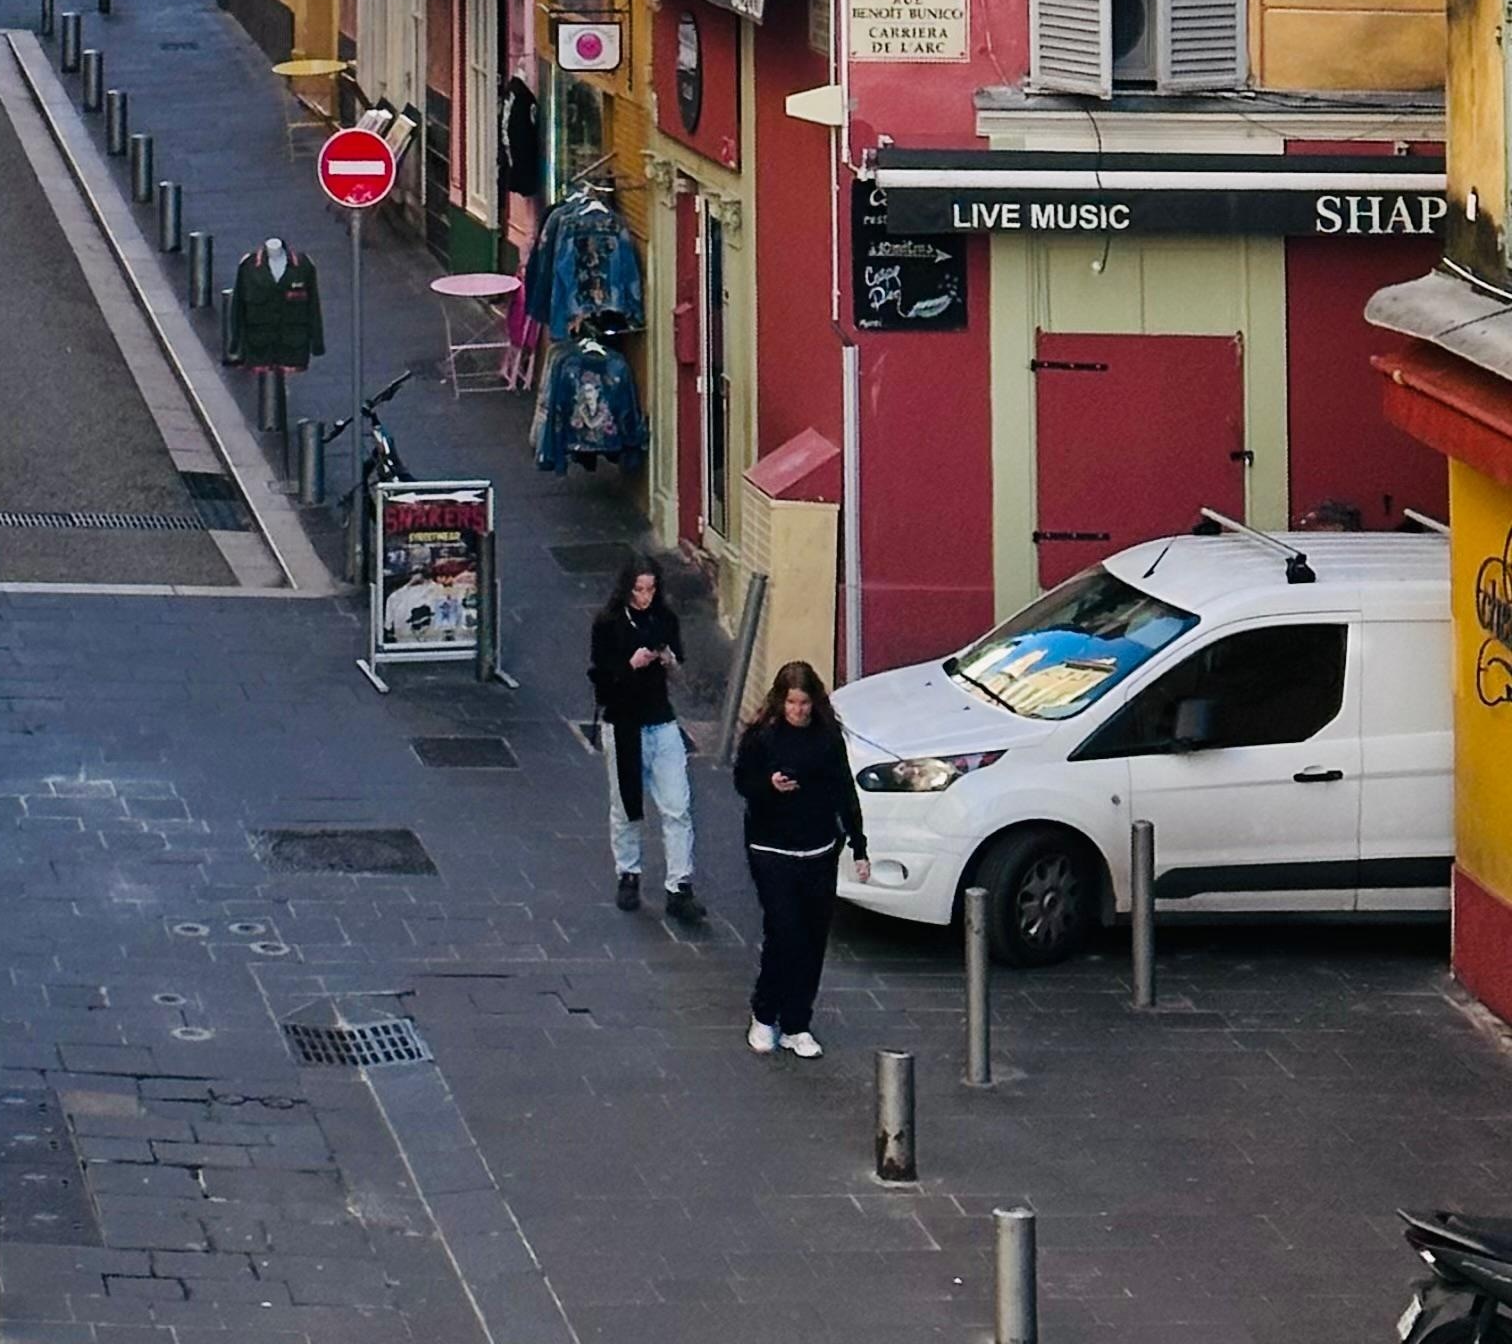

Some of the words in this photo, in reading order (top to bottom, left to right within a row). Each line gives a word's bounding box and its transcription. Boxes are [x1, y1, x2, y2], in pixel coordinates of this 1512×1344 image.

[909, 7, 963, 20] BUNICO
[869, 26, 948, 39] CARRIERA
[872, 42, 891, 53] DE
[901, 42, 946, 54] L'ARC
[953, 203, 1021, 229] LIVE
[1030, 203, 1130, 230] MUSIC
[1316, 195, 1448, 234] SHAP
